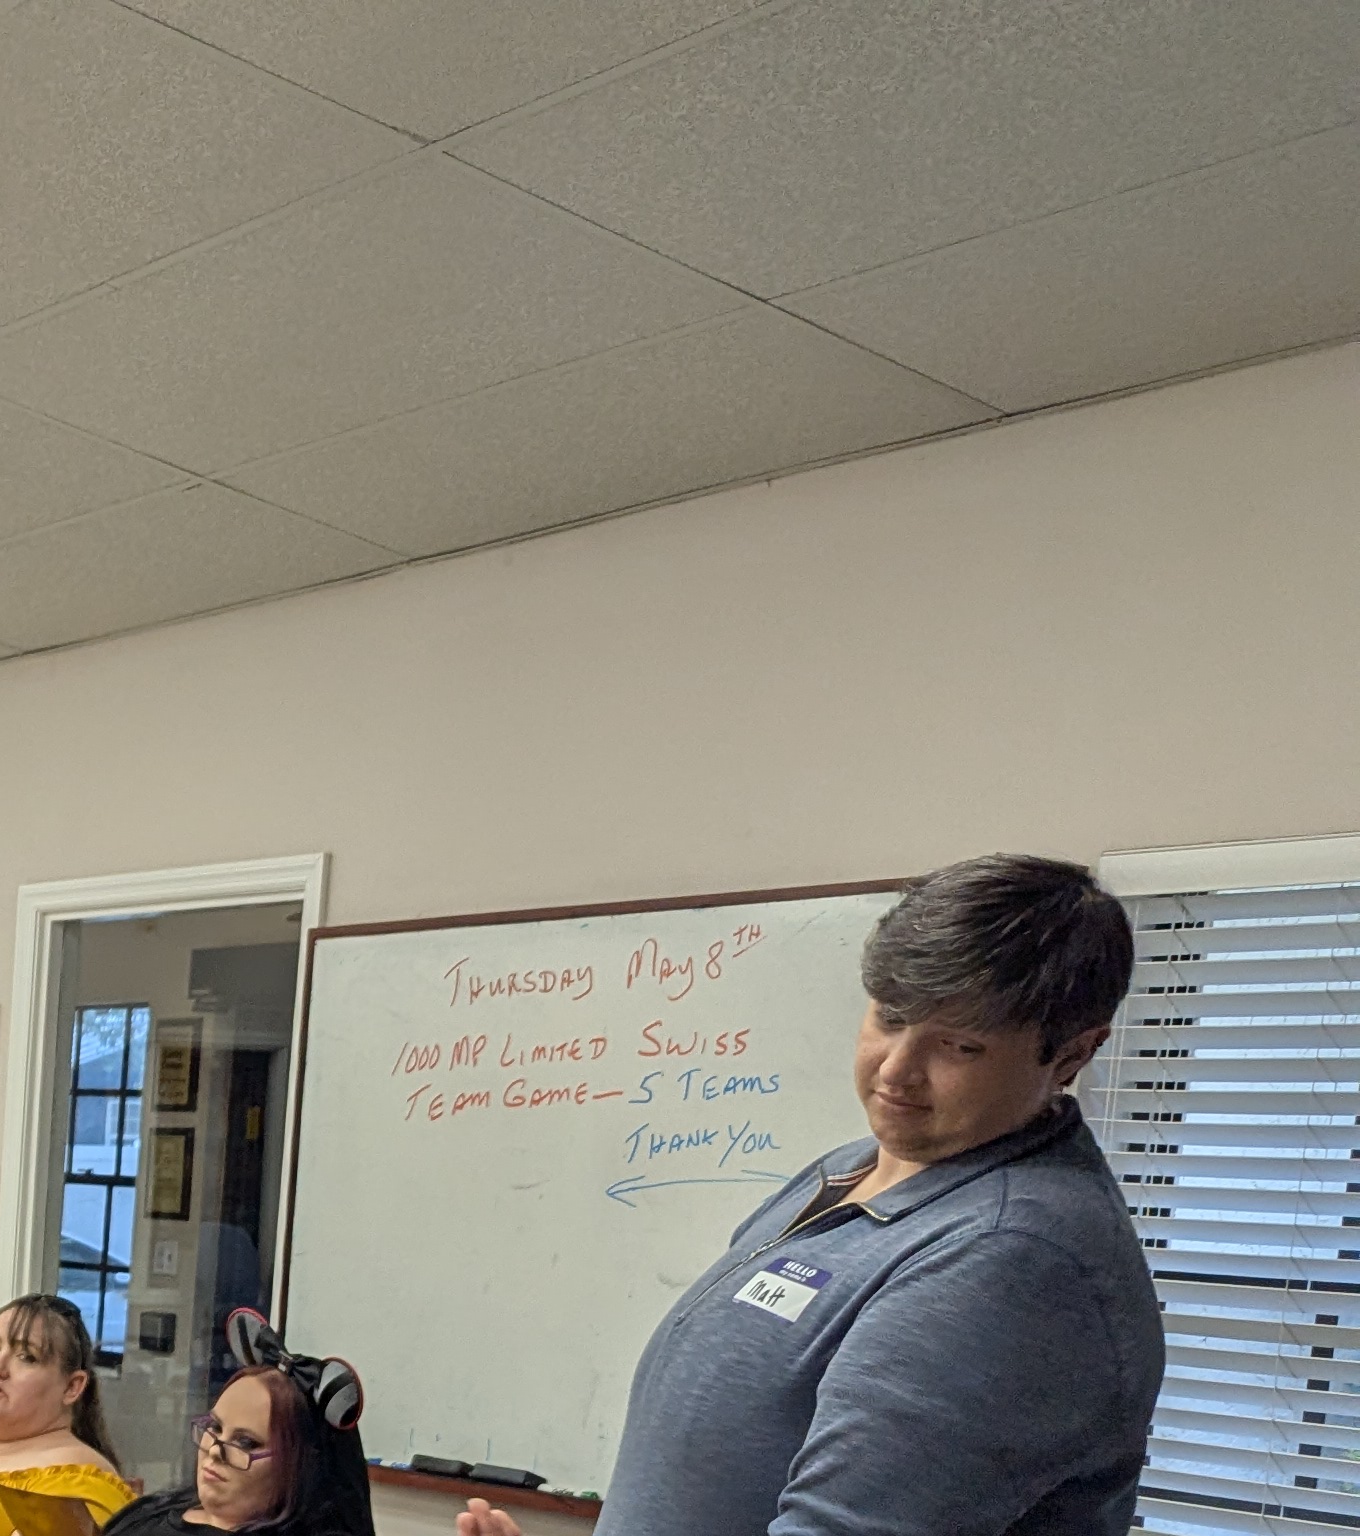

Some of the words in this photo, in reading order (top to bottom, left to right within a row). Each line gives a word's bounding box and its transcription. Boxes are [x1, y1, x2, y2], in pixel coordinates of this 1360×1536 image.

[444, 956, 593, 1008] THURSDAY
[391, 1041, 441, 1077] 1000
[449, 1034, 487, 1071] MP
[500, 1033, 608, 1068] LIMITED
[638, 1019, 751, 1058] SWISS
[405, 1084, 490, 1122] TEAM
[677, 1068, 780, 1100] TEAMS
[625, 1123, 719, 1164] THANK
[719, 1120, 781, 1168] YOU
[747, 1279, 786, 1308] Matt
[783, 1260, 818, 1278] HELLO
